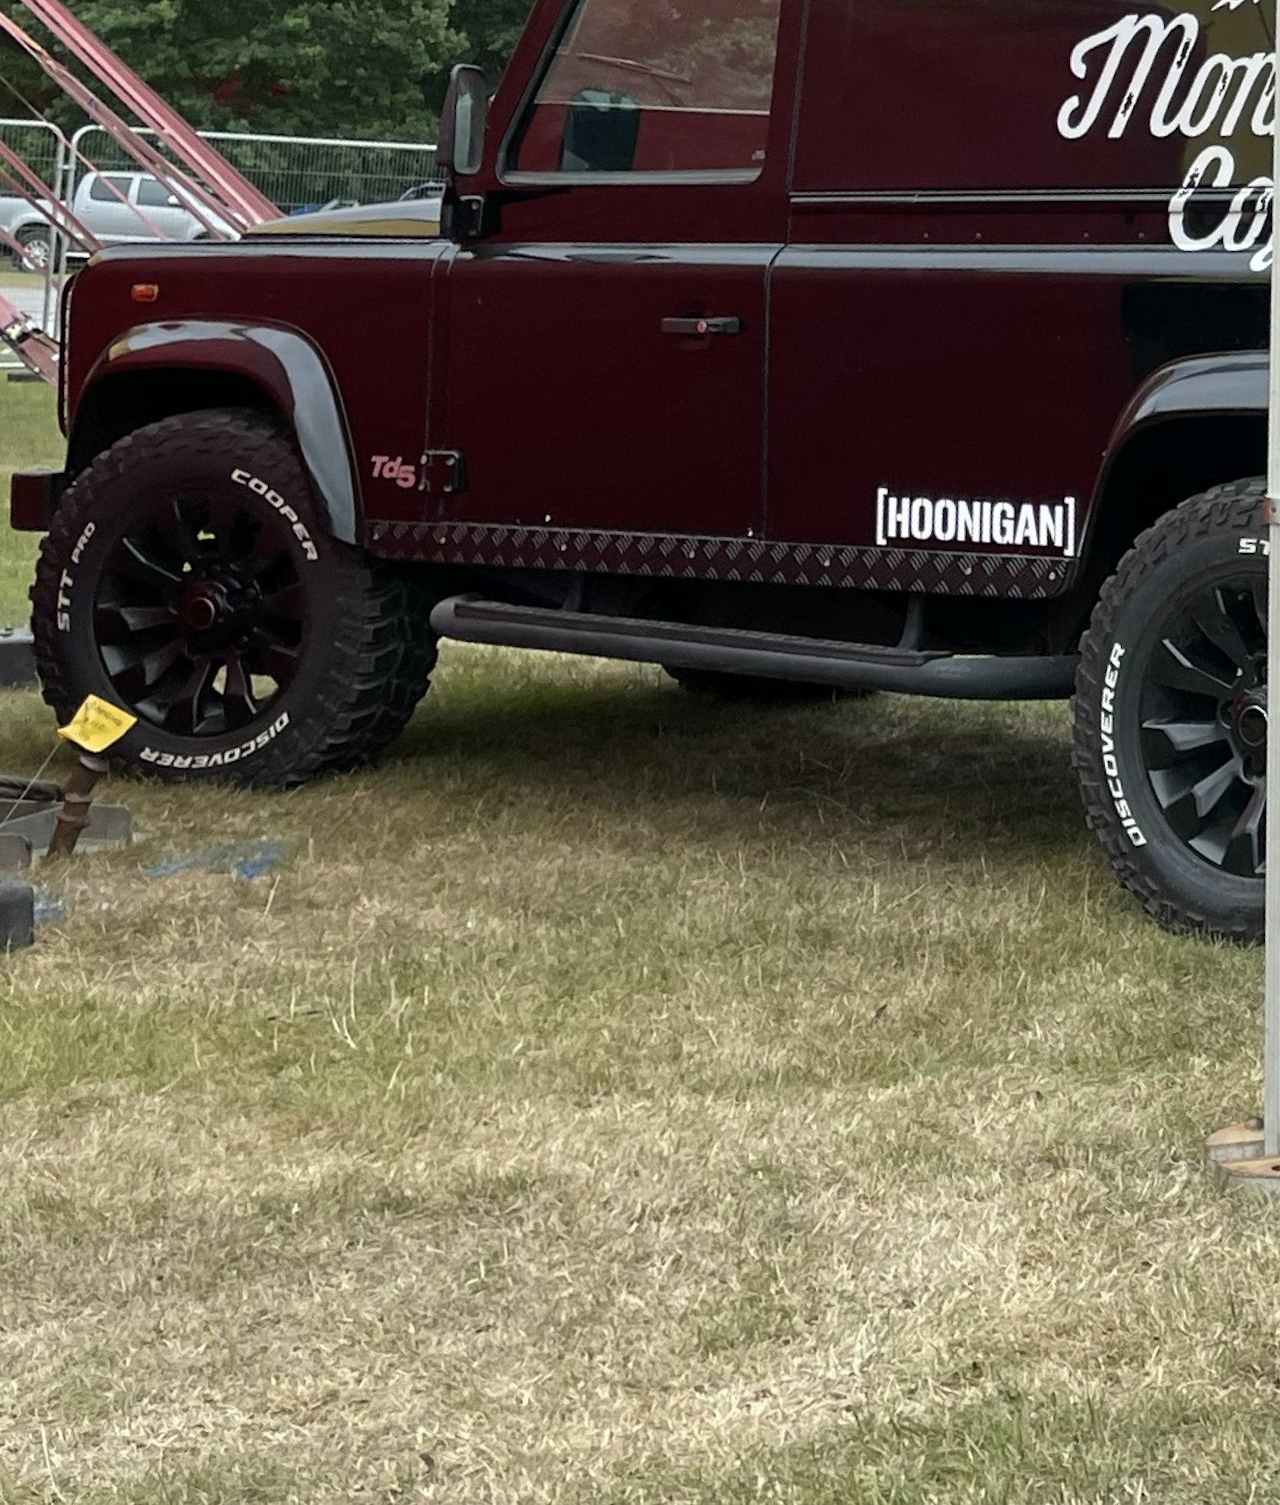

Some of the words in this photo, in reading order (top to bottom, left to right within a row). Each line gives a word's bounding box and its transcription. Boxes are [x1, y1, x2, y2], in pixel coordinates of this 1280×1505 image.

[230, 468, 318, 562] COOPER
[370, 455, 415, 488] Td5
[57, 569, 73, 632] STT
[71, 521, 96, 564] PRO
[140, 711, 289, 769] DISCOVERER
[1100, 641, 1147, 848] DISCOVERER
